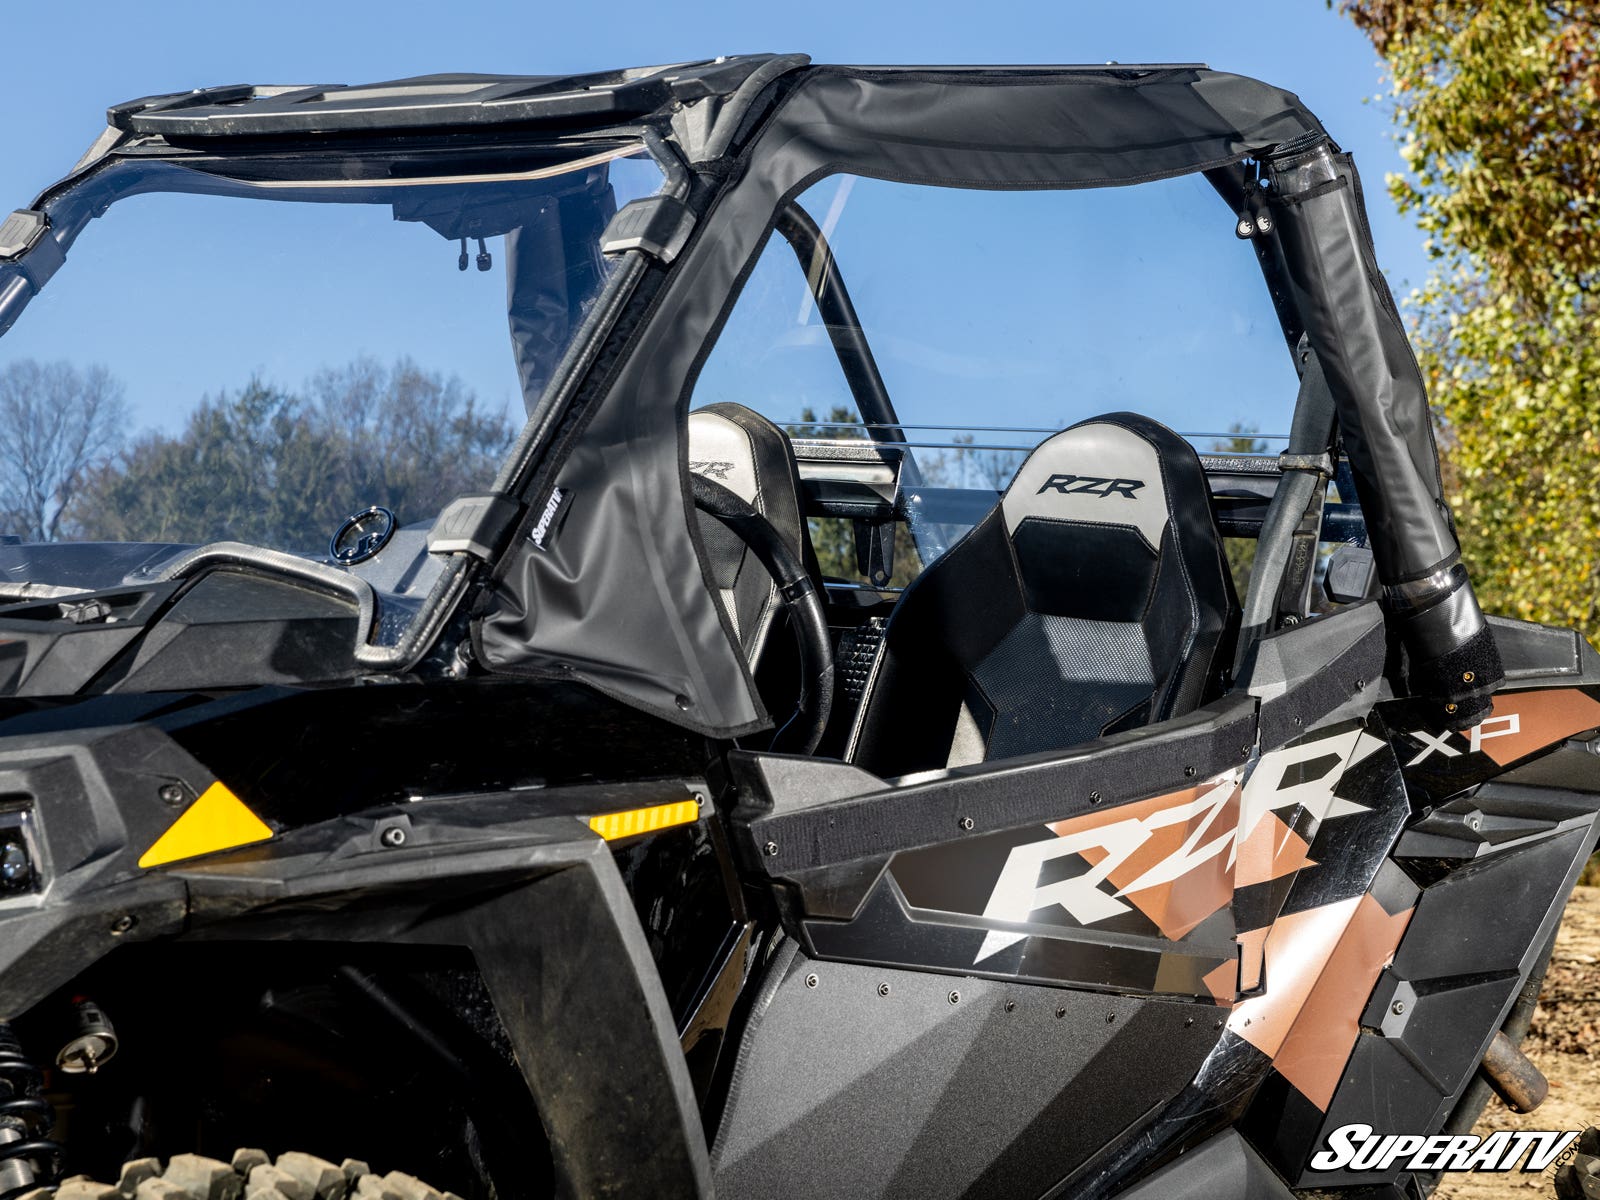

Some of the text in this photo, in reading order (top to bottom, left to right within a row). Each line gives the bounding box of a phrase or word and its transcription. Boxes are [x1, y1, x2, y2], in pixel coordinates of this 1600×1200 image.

[1035, 473, 1146, 500] RZR
[1405, 713, 1521, 767] XP
[973, 728, 1388, 965] RZR
